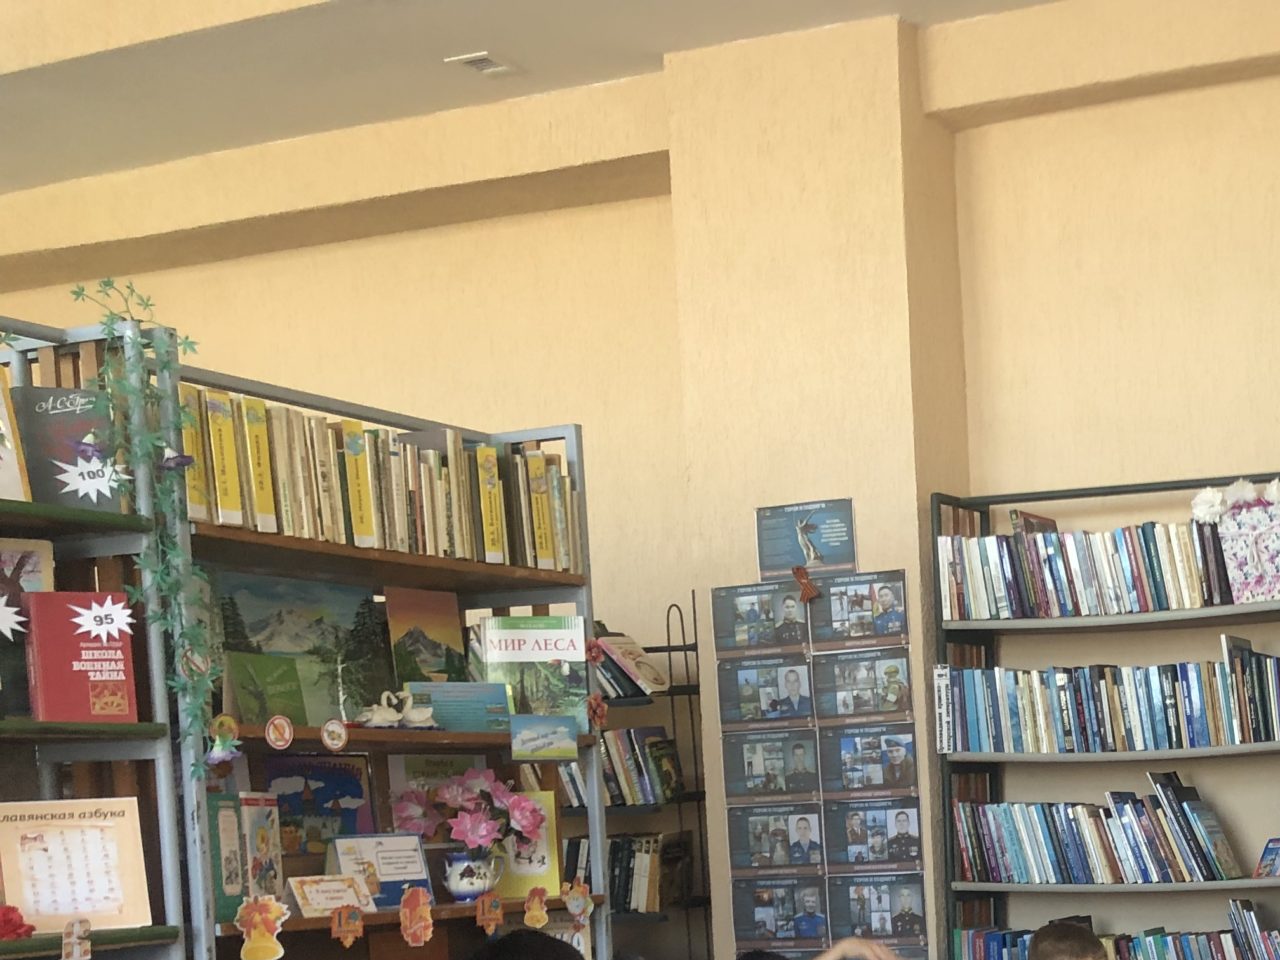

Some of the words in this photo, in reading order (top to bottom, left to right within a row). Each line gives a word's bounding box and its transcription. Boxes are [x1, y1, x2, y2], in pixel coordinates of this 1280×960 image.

[78, 468, 106, 482] 100
[93, 613, 115, 627] 95
[489, 639, 527, 651] МИР
[531, 638, 578, 651] ЛЕСА
[0, 812, 75, 823] лавянская
[78, 807, 126, 820] азбука
